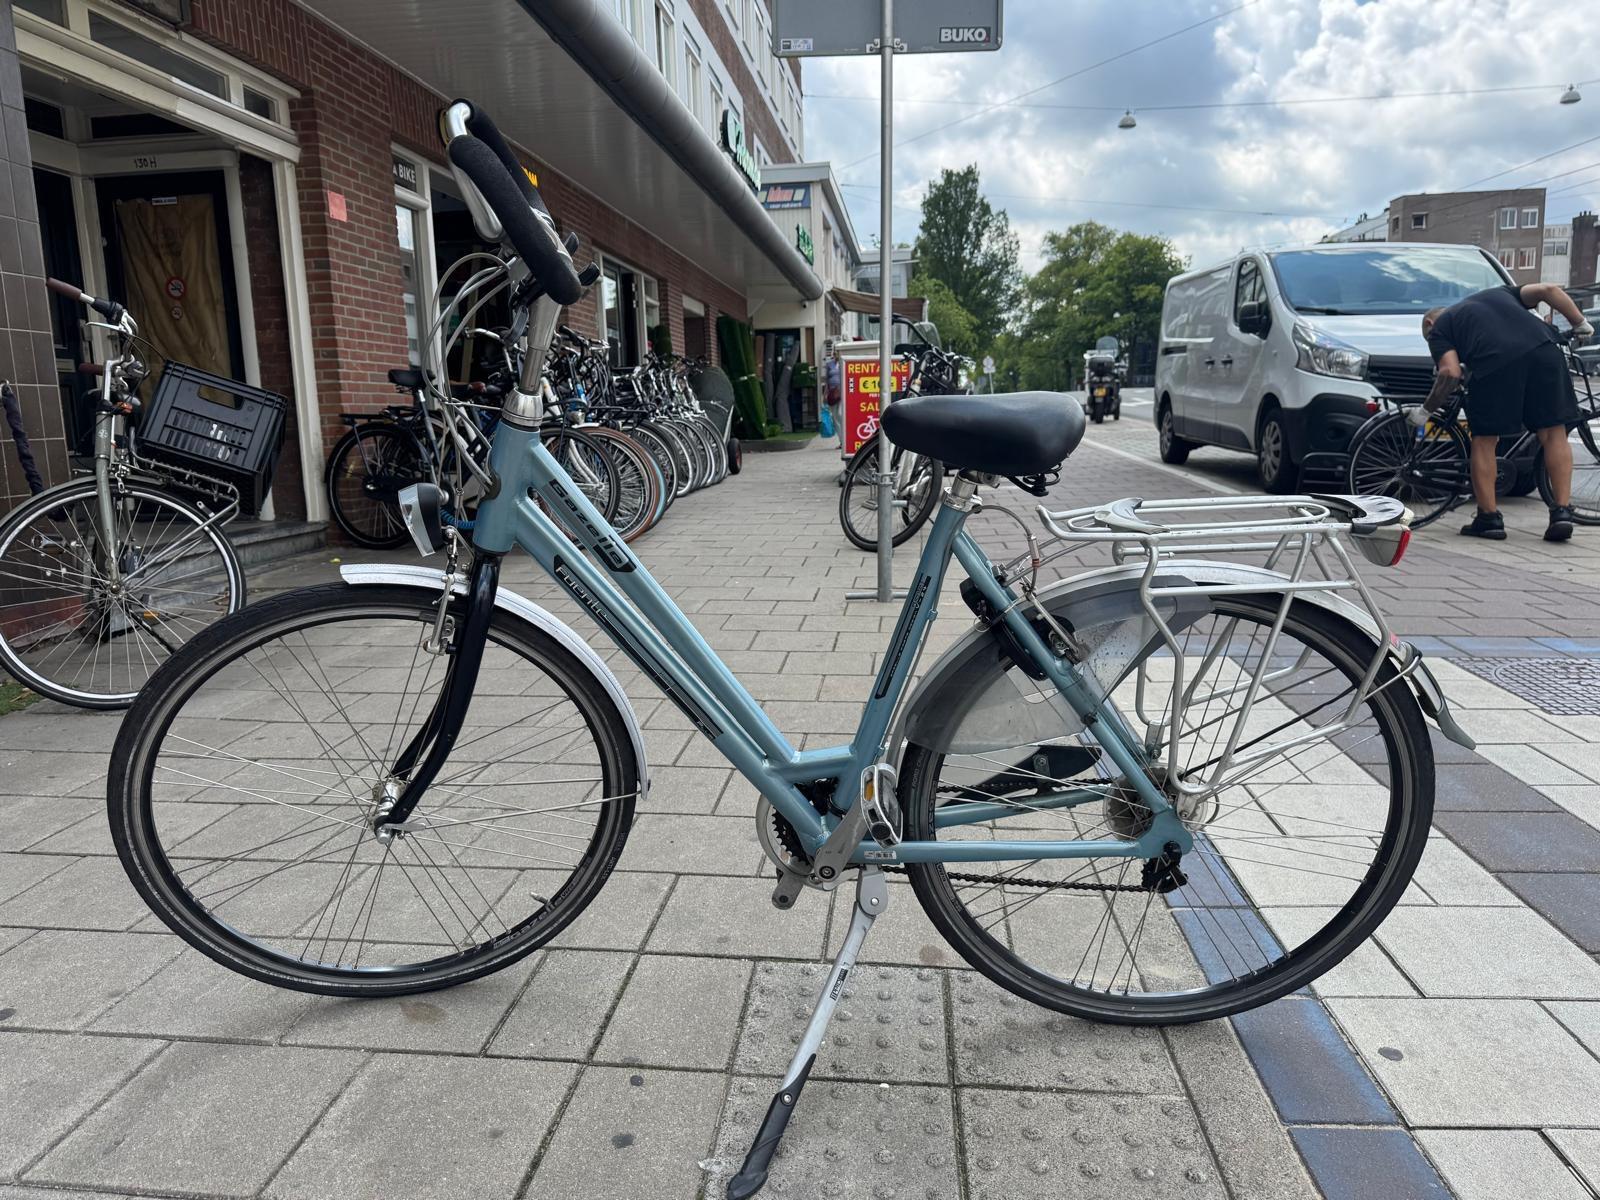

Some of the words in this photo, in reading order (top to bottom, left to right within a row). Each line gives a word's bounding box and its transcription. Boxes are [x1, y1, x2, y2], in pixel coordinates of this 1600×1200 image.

[398, 163, 416, 183] BIKE
[848, 363, 875, 373] RENT
[860, 402, 880, 412] SAL
[551, 480, 622, 566] Gazelle
[555, 565, 608, 624] Fuente
